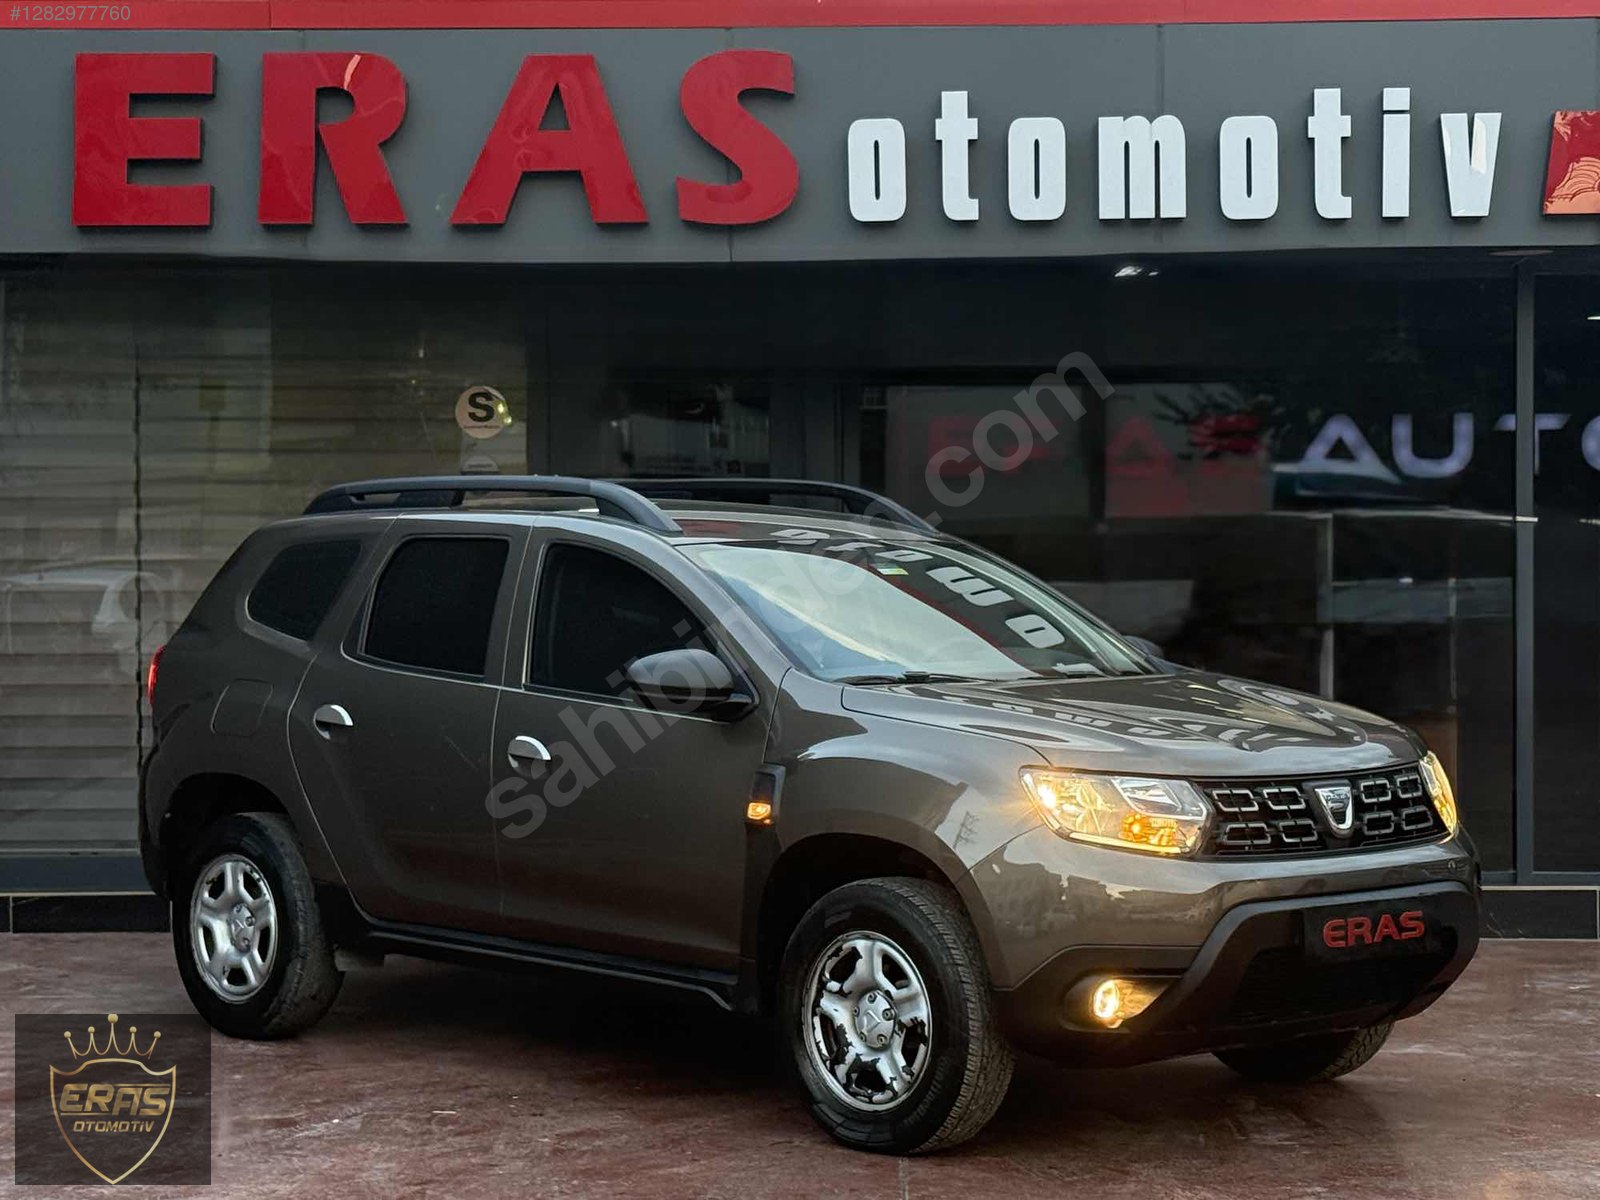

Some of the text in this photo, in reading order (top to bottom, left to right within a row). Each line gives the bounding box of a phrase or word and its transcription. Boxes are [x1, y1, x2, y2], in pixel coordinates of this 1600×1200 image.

[72, 50, 1502, 228] ERAS otomotiv
[1323, 911, 1425, 948] ERAS
